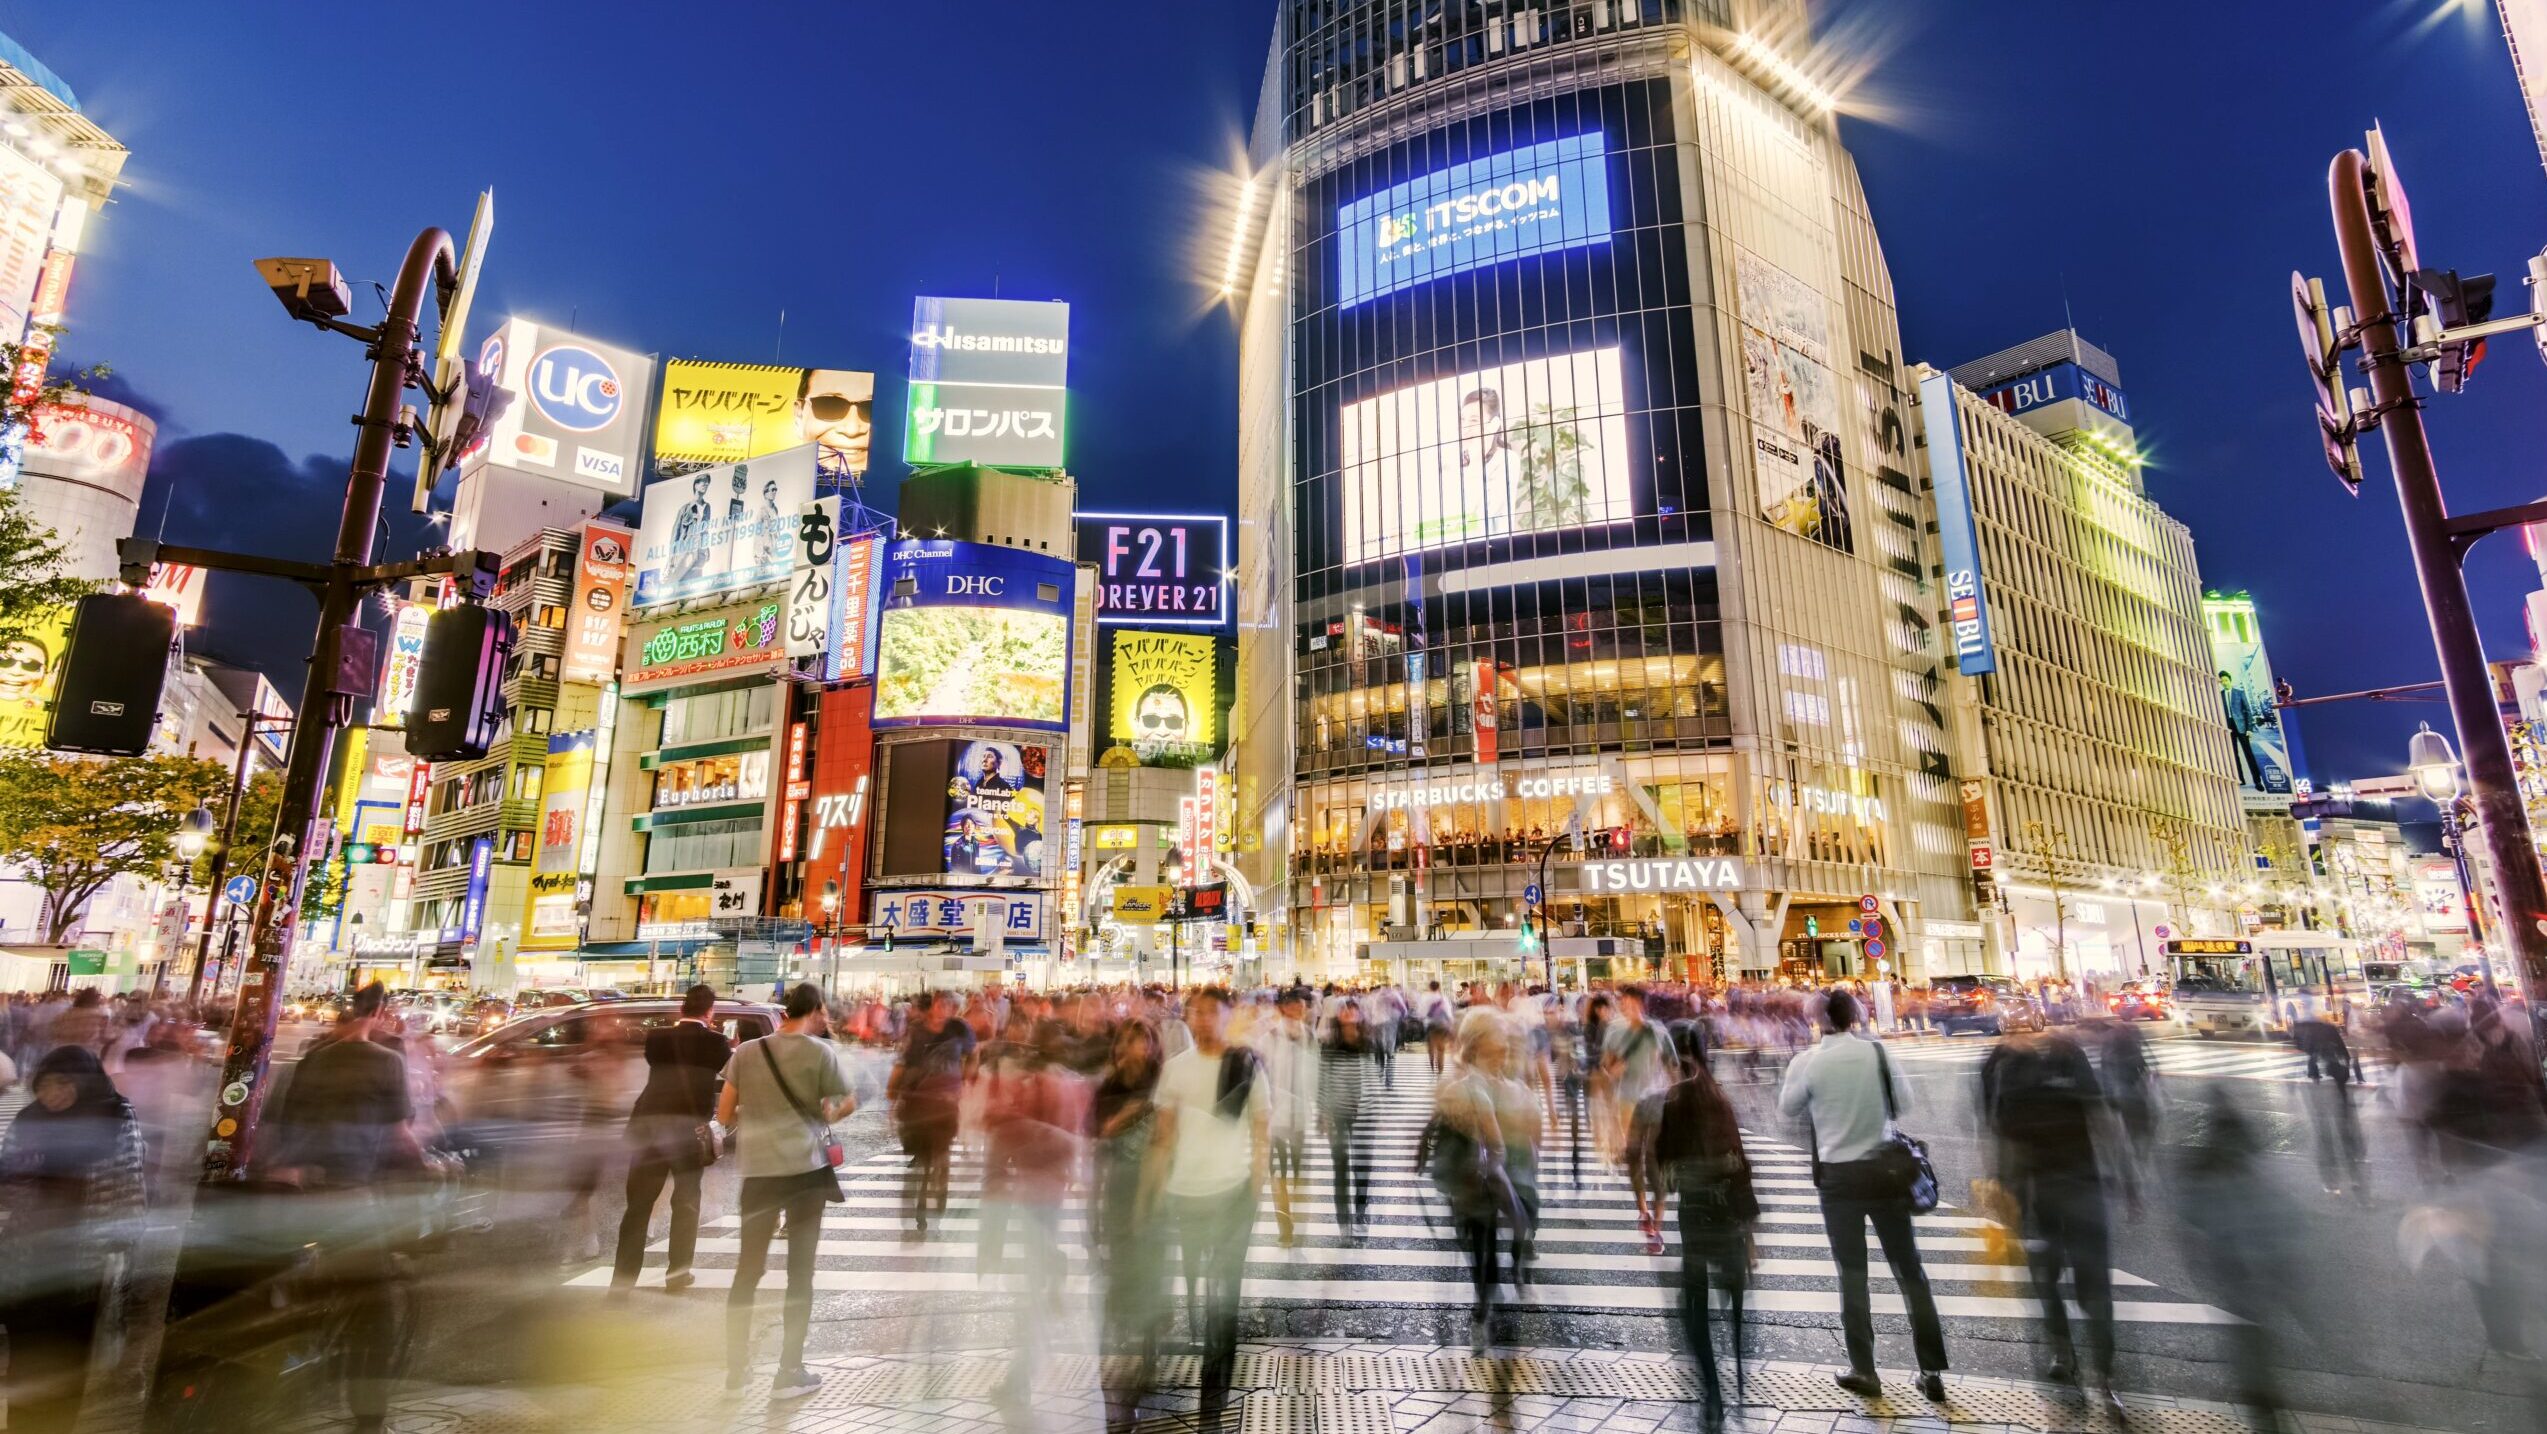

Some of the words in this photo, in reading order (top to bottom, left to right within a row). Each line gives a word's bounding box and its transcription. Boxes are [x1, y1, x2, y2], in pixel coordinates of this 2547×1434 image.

[912, 325, 1064, 354] Hisamitsu
[672, 387, 789, 415] ヤバババーン
[1996, 374, 2056, 414] IBU
[2082, 374, 2128, 420] SEIBU
[912, 406, 1055, 439] サロンパス
[582, 454, 621, 477] VISA
[646, 546, 667, 561] ALL
[700, 531, 730, 549] BEST
[892, 549, 914, 561] DHC
[914, 548, 953, 559] Channel
[1106, 526, 1187, 578] F21
[789, 502, 834, 650] もんじゃ
[945, 574, 1004, 596] DHC
[1859, 349, 1951, 792] TSUTAYA
[839, 545, 865, 670] 三千里薬品
[1097, 584, 1186, 611] OREVER
[1193, 585, 1217, 611] 21
[1947, 568, 1985, 656] SEIBU
[677, 629, 725, 660] 西村
[1119, 638, 1210, 664] ヤバババーン
[1128, 657, 1199, 678] ヤバババーン
[1135, 673, 1190, 690] ヤバババーン
[659, 783, 738, 805] Euphoria
[967, 794, 1026, 813] Planets
[976, 786, 1012, 798] teamLab
[1373, 779, 1505, 810] STARBUCKS
[1518, 775, 1611, 798] COFFEE
[1803, 785, 1890, 822] TSUTAYA
[809, 774, 868, 861] クスリ
[1200, 778, 1212, 839] カラオケ
[1218, 834, 1229, 844] 4F
[1974, 850, 1990, 865] 本
[1584, 860, 1740, 890] TSUTAYA
[881, 899, 1033, 929] 大盛堂店
